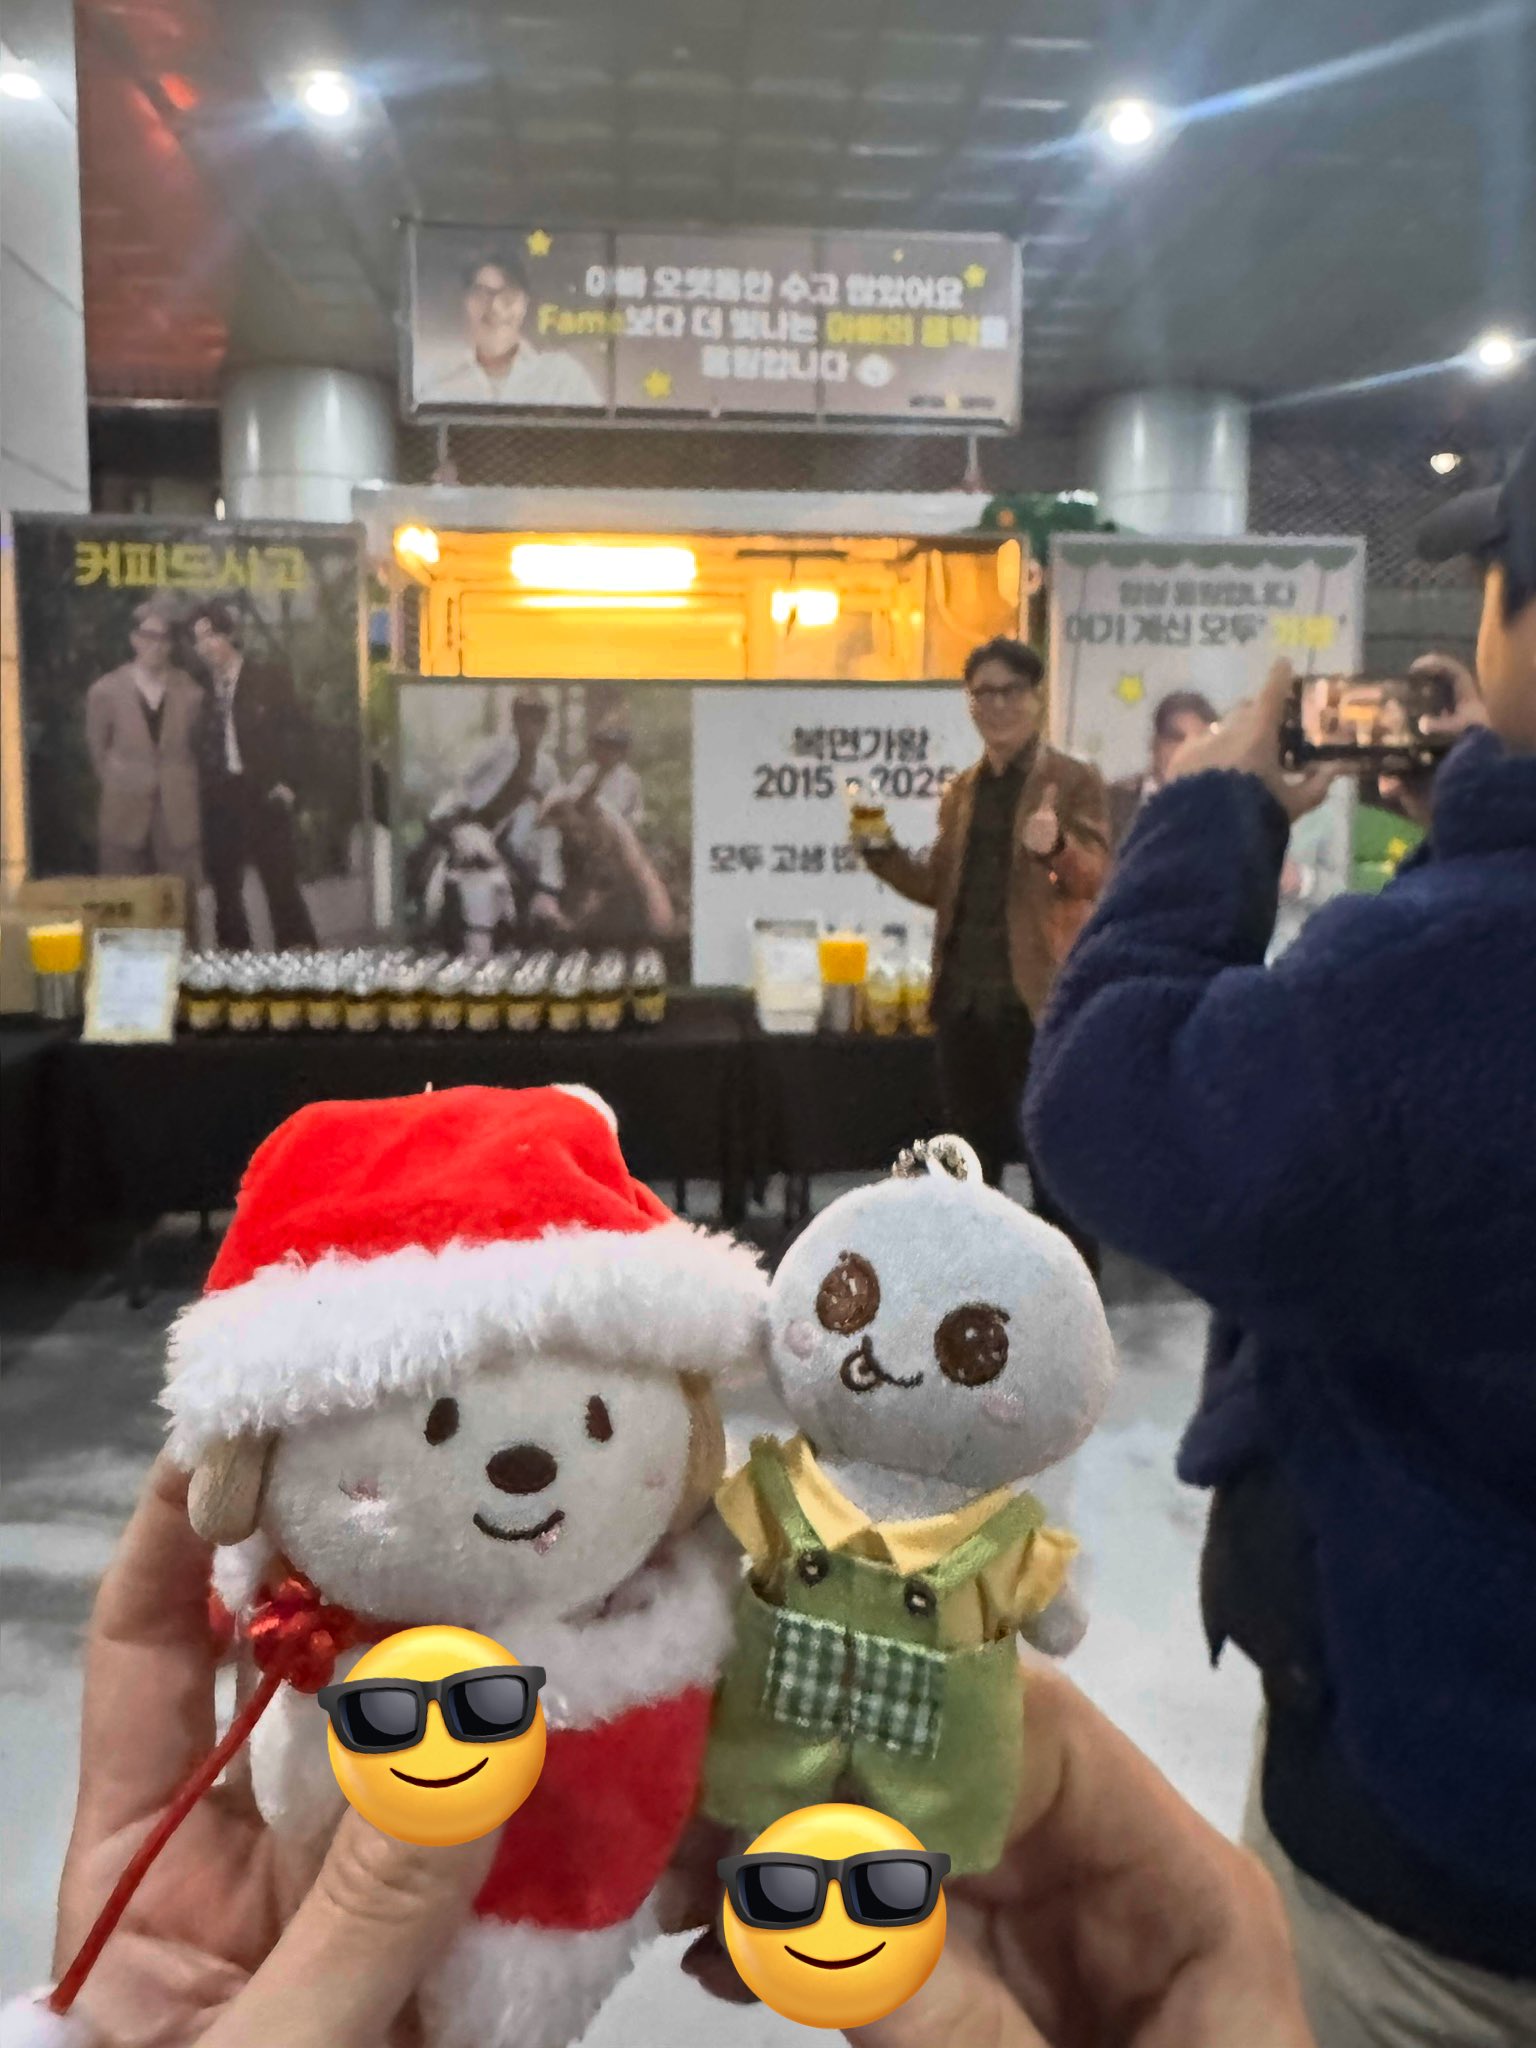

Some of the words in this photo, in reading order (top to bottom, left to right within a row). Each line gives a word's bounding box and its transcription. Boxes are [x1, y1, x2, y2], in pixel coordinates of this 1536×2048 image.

[653, 266, 773, 303] 오랫동안
[780, 271, 839, 306] 수고
[692, 305, 723, 339] 더
[730, 306, 818, 343] 빛나는
[1066, 613, 1125, 646] 여기
[1132, 613, 1192, 647] 계신
[794, 726, 929, 761] 복면가왕
[754, 763, 835, 799] 2015
[709, 842, 764, 874] 모두
[770, 842, 827, 874] 고생
